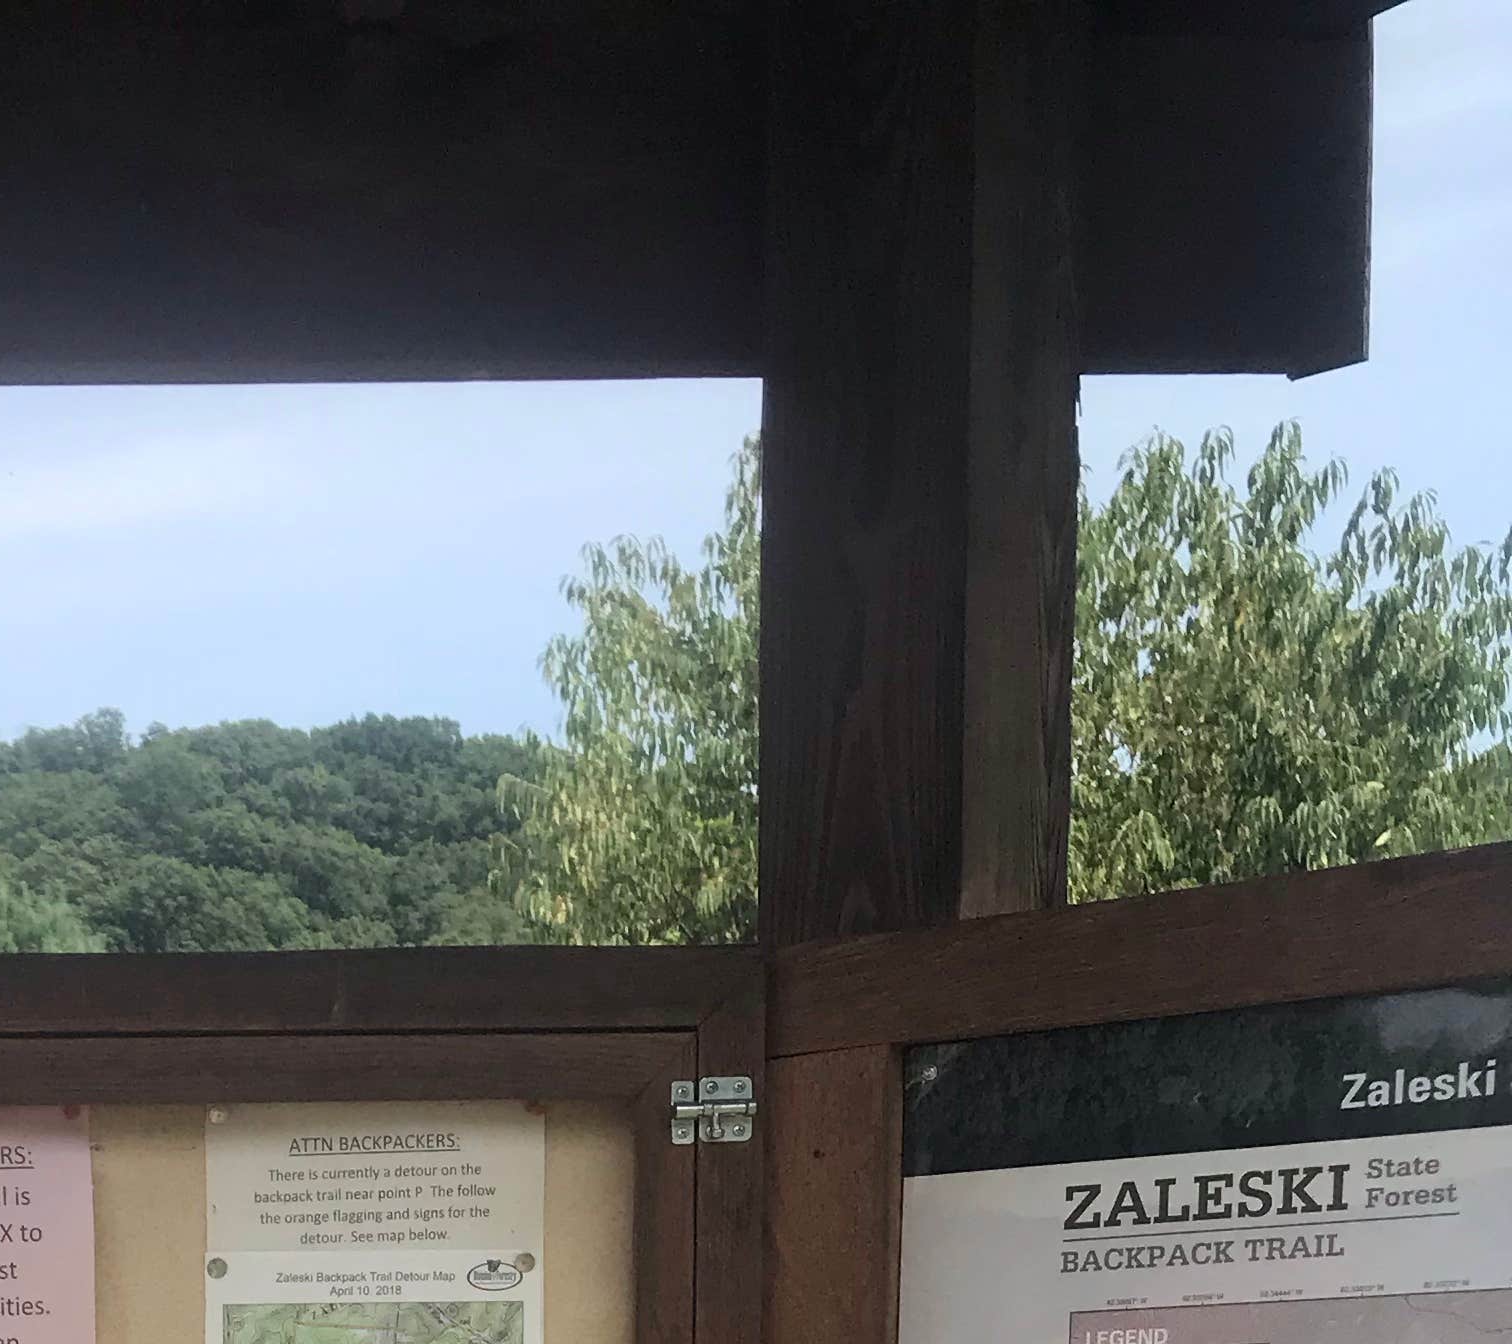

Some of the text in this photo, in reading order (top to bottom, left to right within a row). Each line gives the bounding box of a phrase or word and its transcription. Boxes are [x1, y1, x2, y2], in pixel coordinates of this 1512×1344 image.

[1341, 1059, 1496, 1110] Zaleski
[289, 1133, 460, 1153] ATTN BACKPACKERS:
[268, 1163, 482, 1183] There is currently a detour on the
[1364, 1156, 1440, 1179] State
[15, 1186, 30, 1206] is
[254, 1188, 313, 1205] backpack
[316, 1187, 341, 1202] trail
[346, 1190, 374, 1201] near
[378, 1187, 412, 1202] point
[430, 1185, 454, 1198] The
[457, 1184, 497, 1197] follow
[1064, 1163, 1350, 1231] ZALESKI
[1365, 1184, 1457, 1209] Forest
[260, 1205, 490, 1225] the orange flagging and signs for the
[0, 1223, 13, 1243] X
[20, 1225, 42, 1243] to
[300, 1232, 346, 1248] detour.
[351, 1229, 373, 1243] See
[378, 1231, 405, 1244] map
[1060, 1233, 1344, 1274] BACKPACK TRAIL
